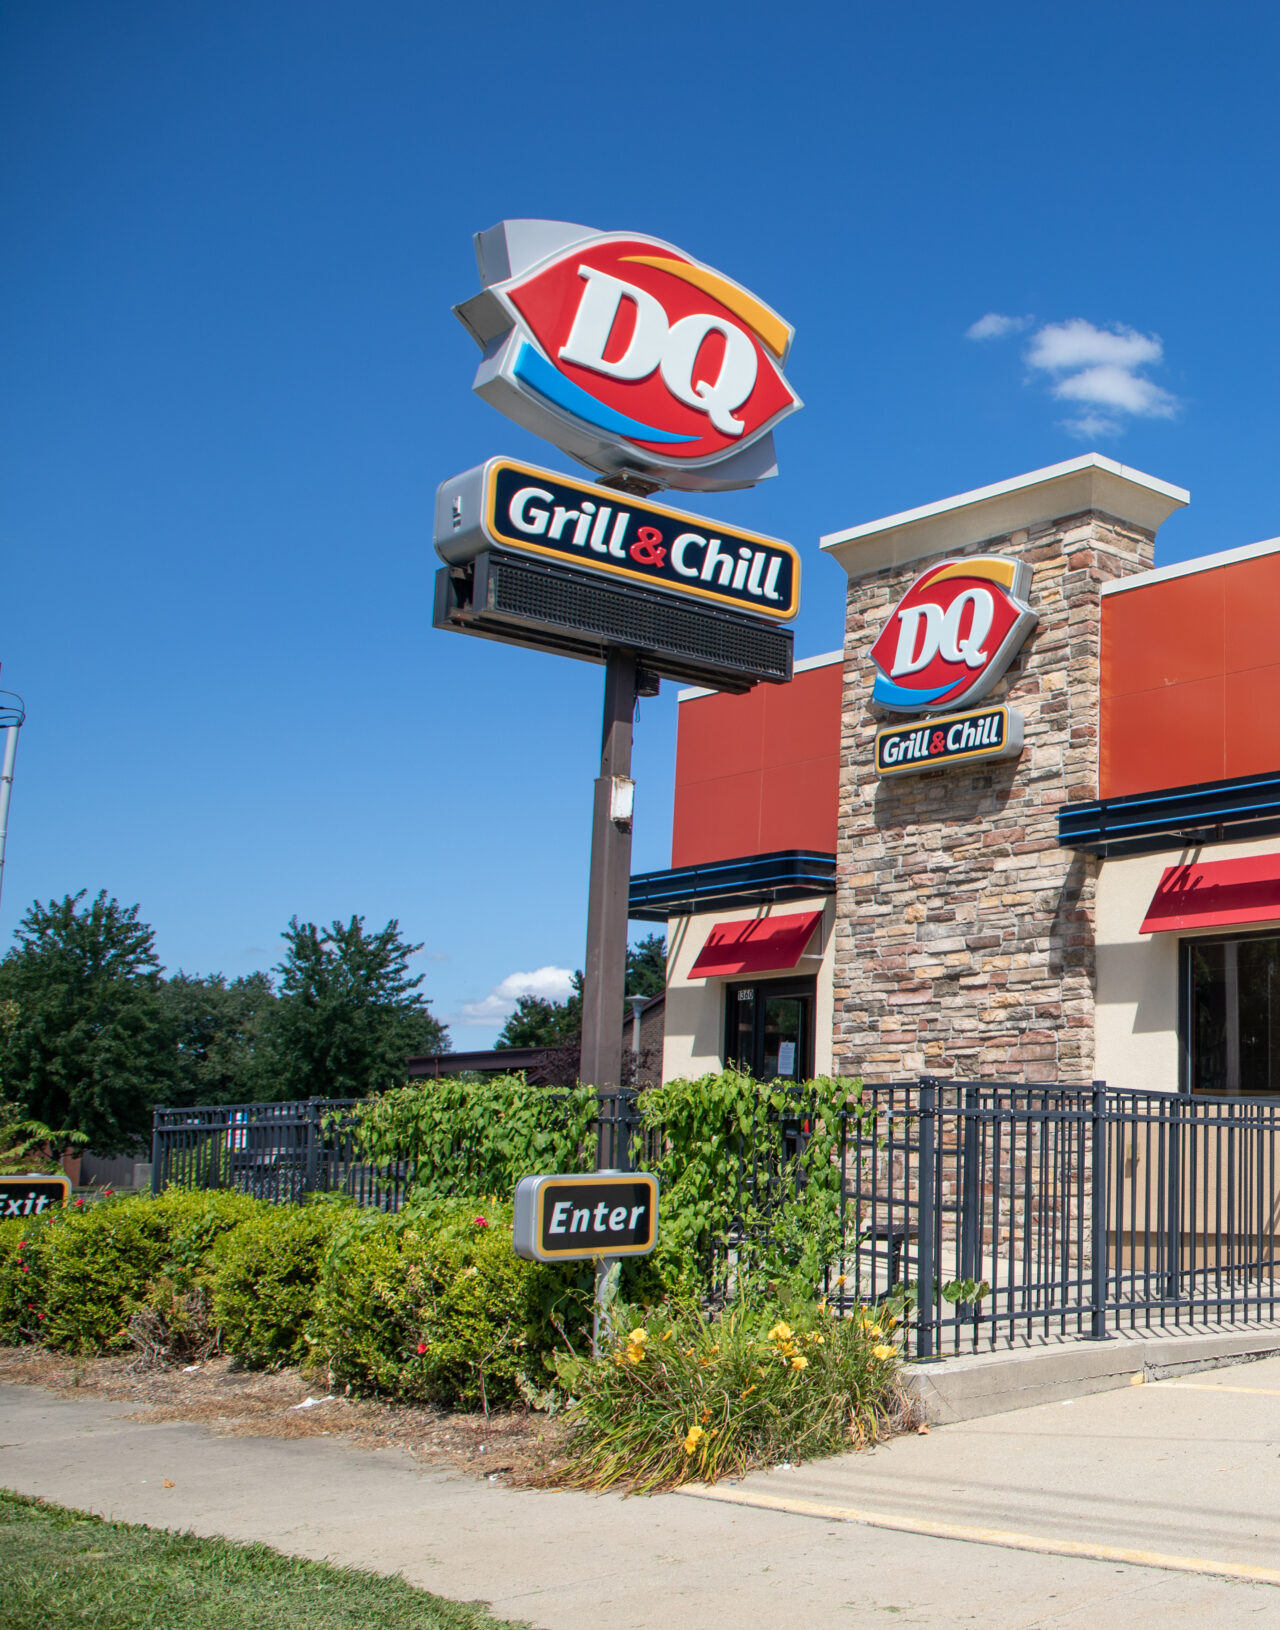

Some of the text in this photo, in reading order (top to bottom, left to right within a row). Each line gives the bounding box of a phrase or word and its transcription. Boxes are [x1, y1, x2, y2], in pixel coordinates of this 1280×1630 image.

[558, 264, 758, 435] DQ
[891, 588, 994, 677] DQ
[549, 1202, 645, 1234] Enter
